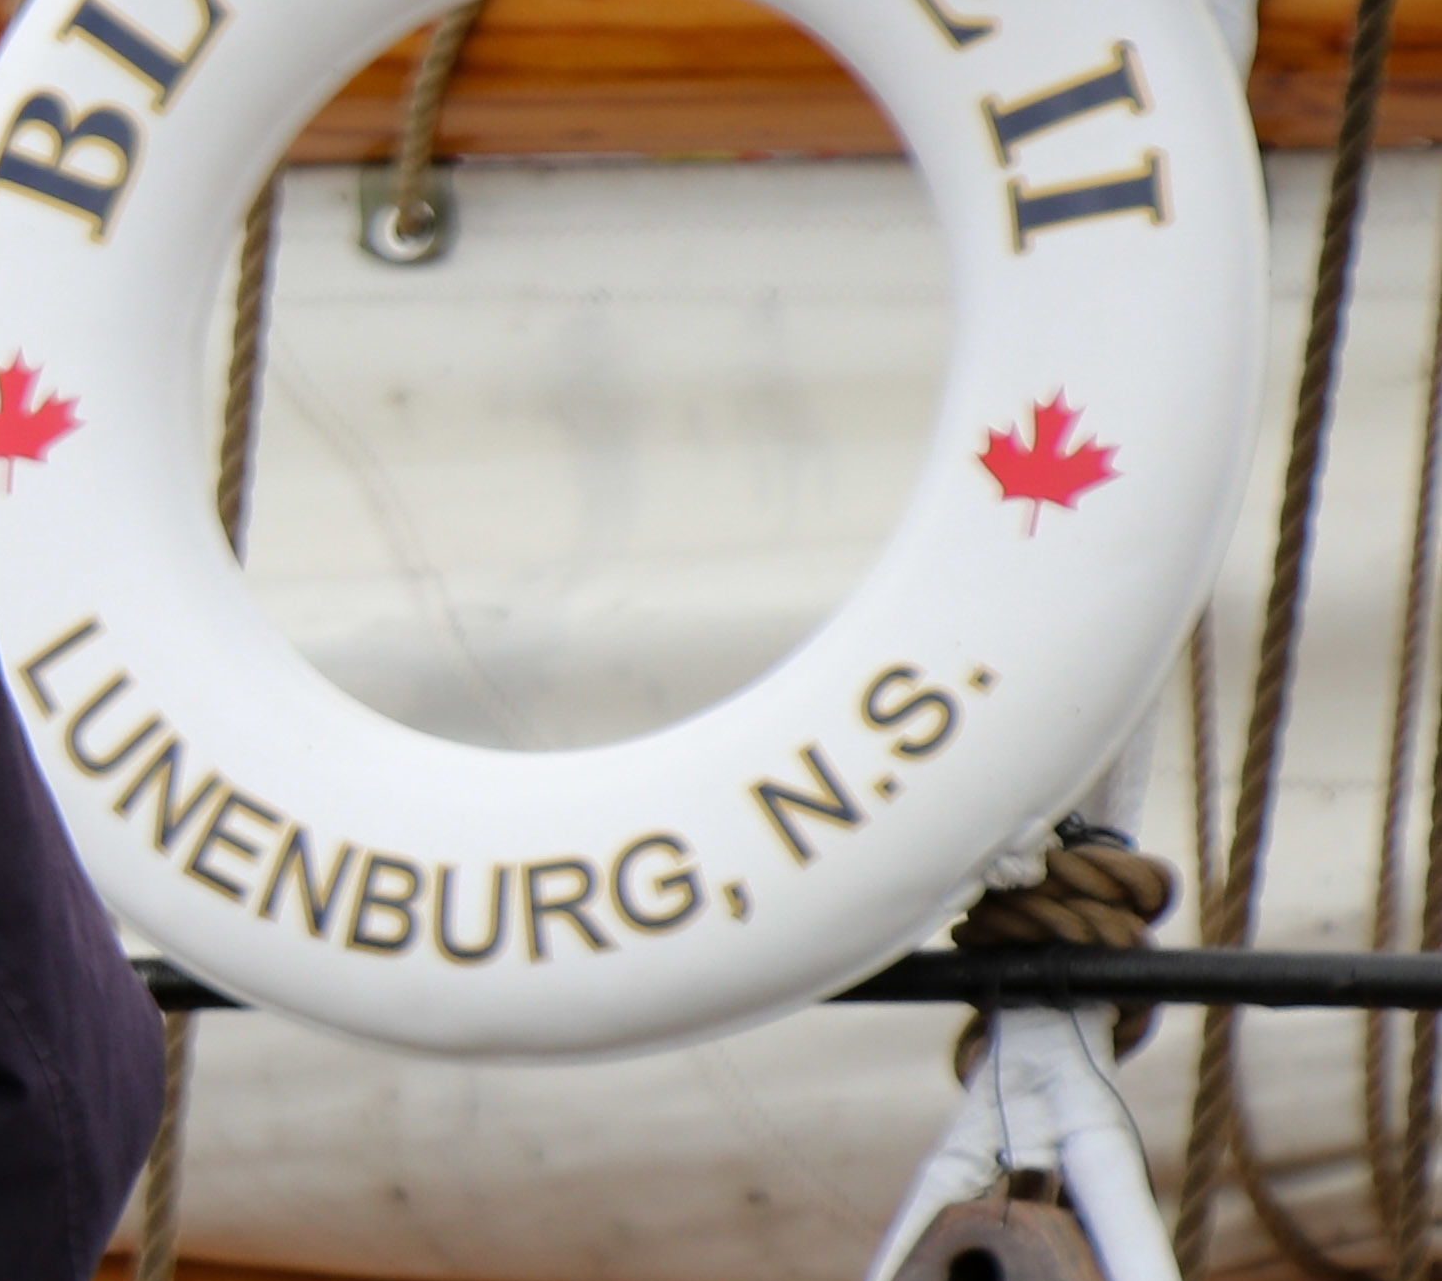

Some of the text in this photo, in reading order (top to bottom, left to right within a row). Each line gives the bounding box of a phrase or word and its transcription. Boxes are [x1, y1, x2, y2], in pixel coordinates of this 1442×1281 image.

[978, 40, 1172, 253] II
[16, 614, 1002, 968] LUNENBURG, N.S.
